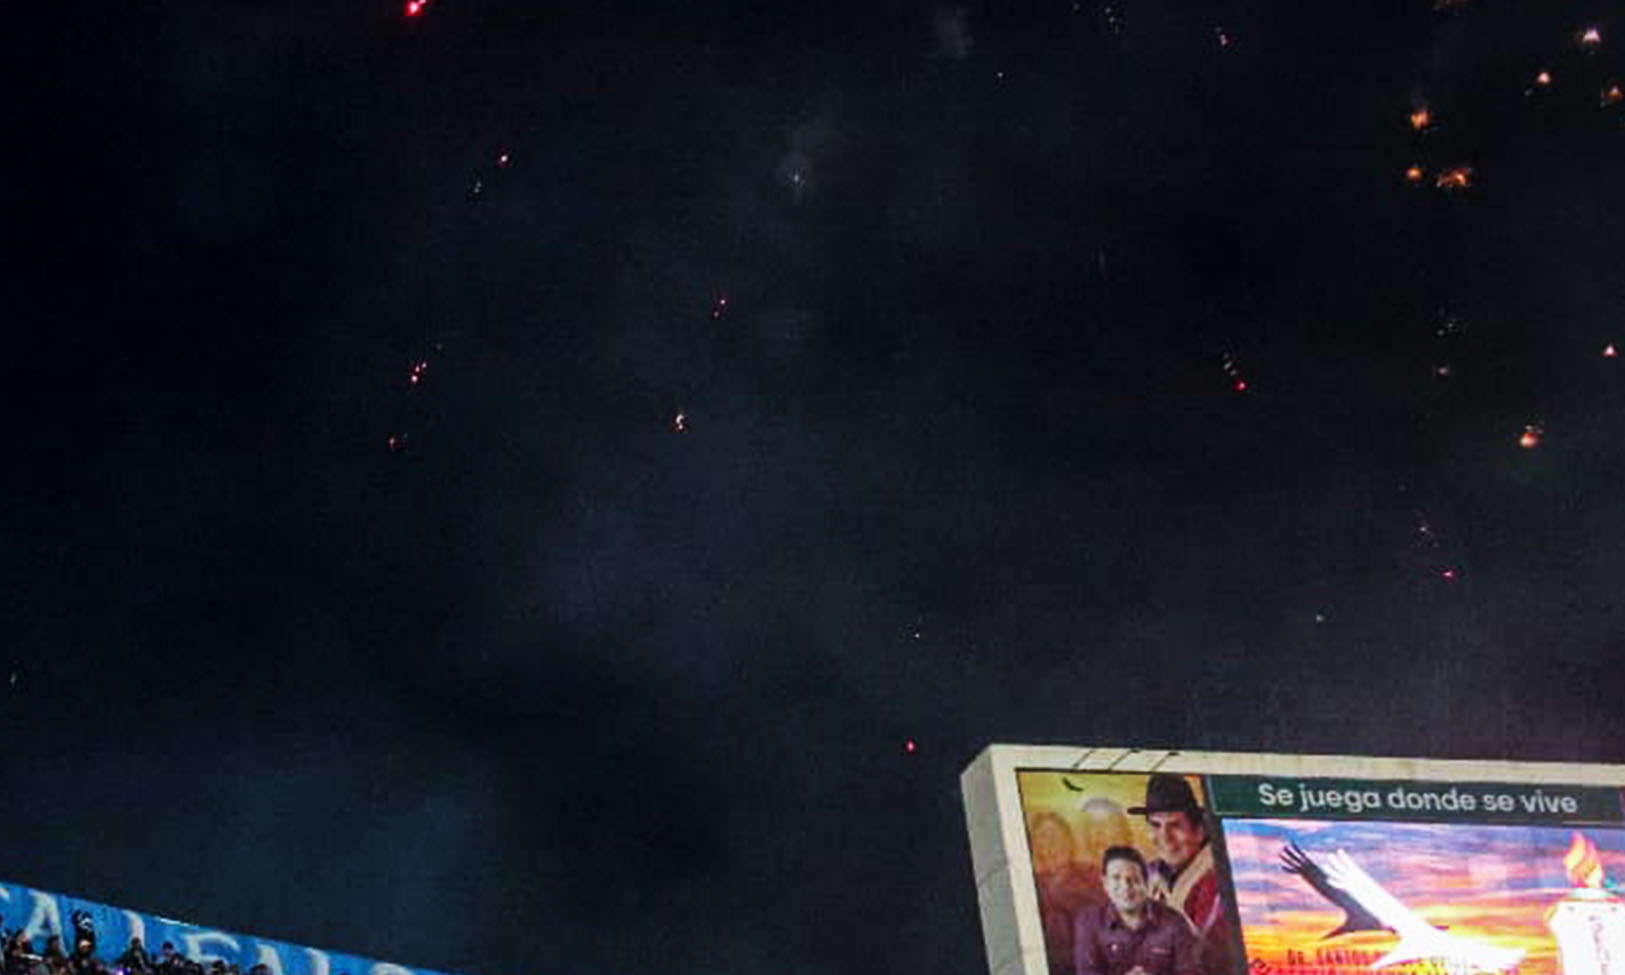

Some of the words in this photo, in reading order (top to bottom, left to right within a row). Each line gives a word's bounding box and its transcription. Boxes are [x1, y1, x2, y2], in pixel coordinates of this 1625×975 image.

[1258, 783, 1294, 806] Se
[1299, 782, 1381, 812] juega
[1387, 787, 1476, 811] donde
[1483, 792, 1515, 812] se
[1522, 789, 1578, 813] vive
